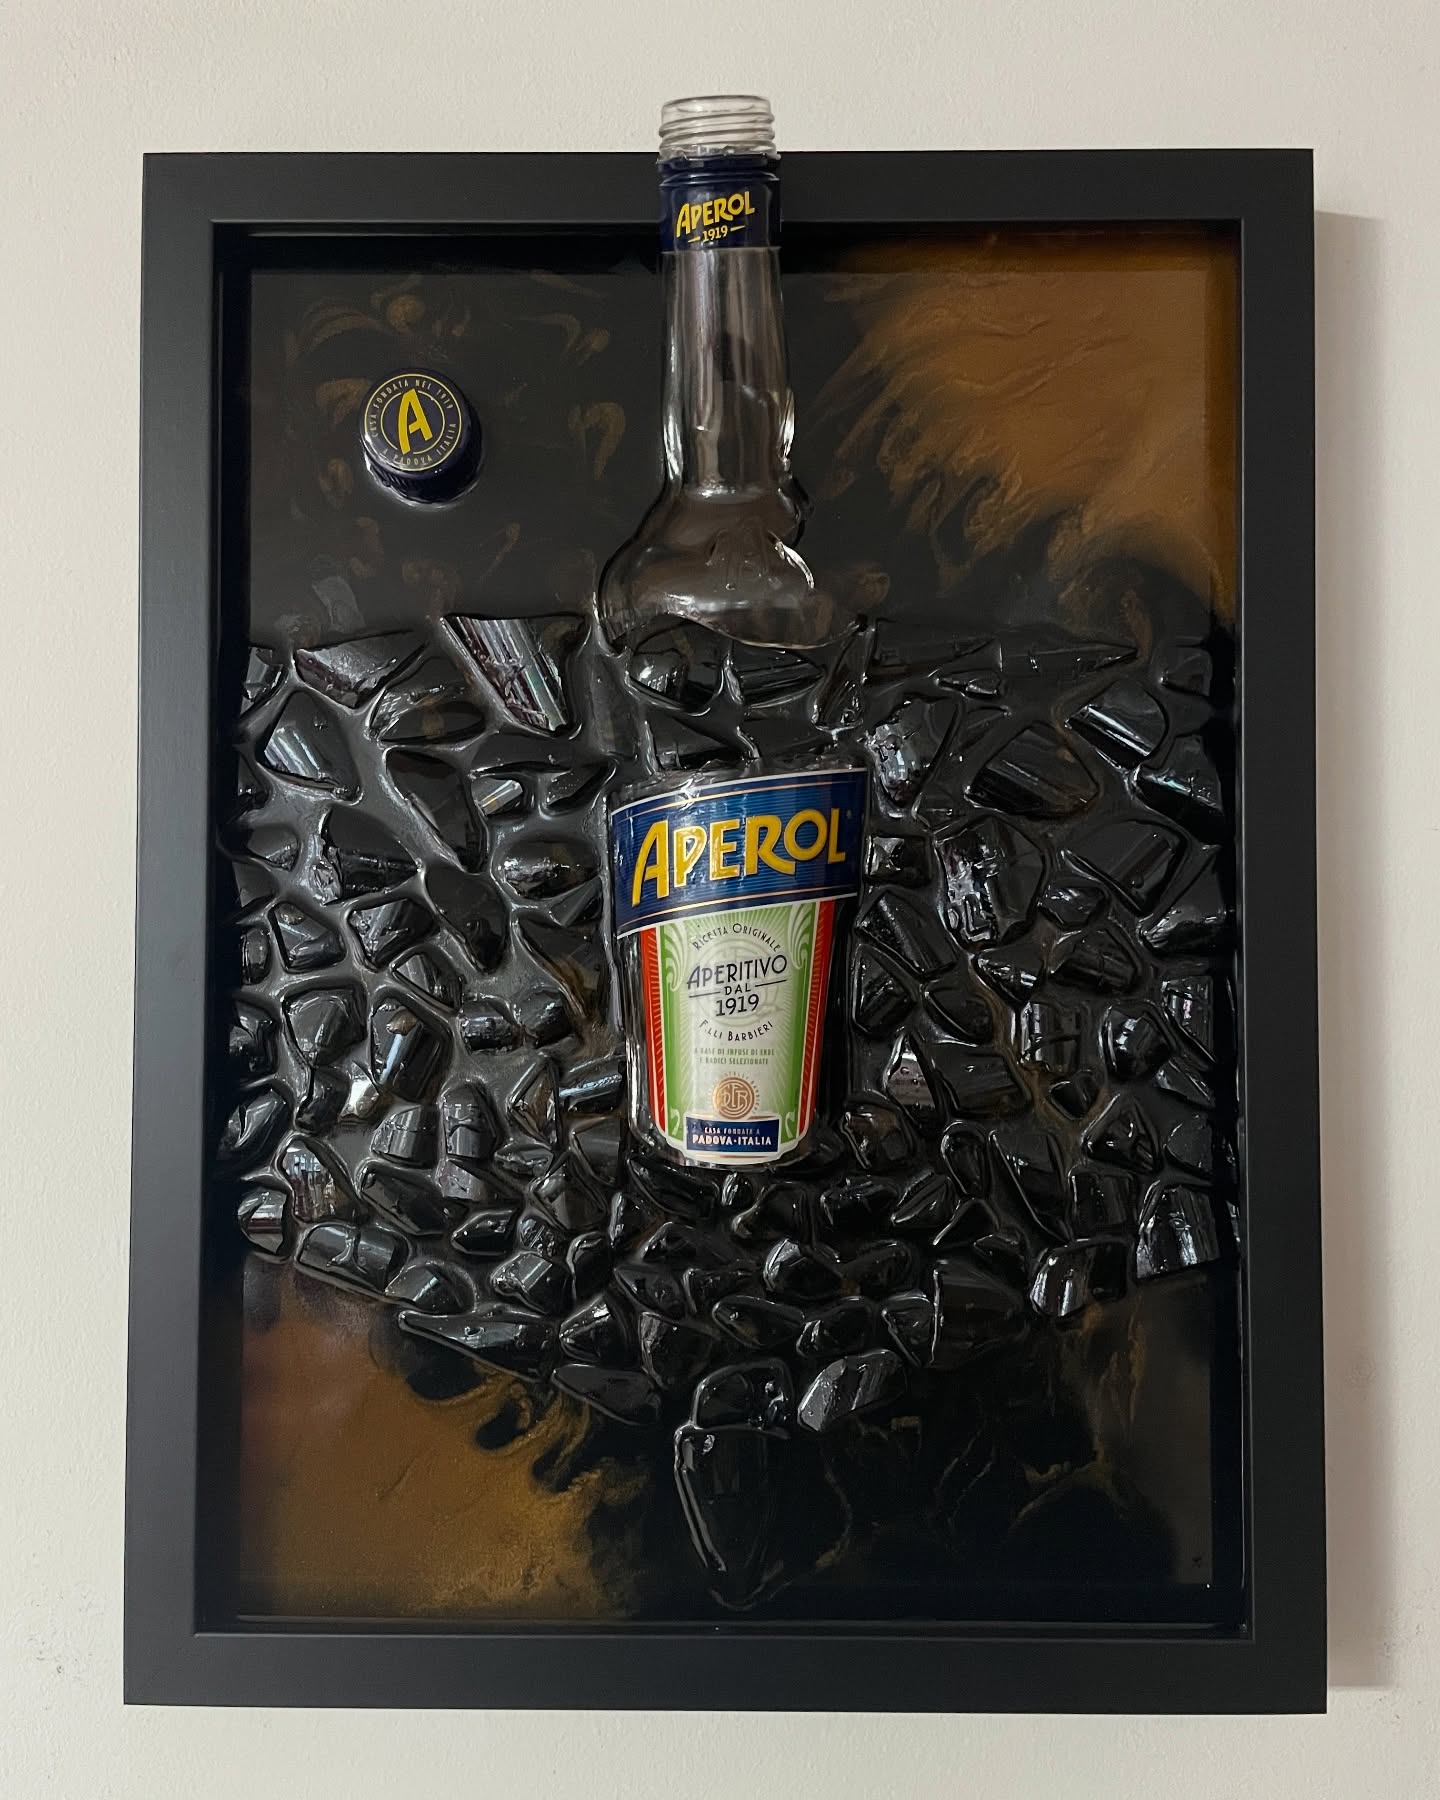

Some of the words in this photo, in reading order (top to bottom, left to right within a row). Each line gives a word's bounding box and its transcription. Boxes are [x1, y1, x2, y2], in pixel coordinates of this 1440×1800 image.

[676, 191, 756, 238] APEROL
[702, 225, 728, 242] 1919
[373, 379, 409, 409] FONDATA
[415, 379, 432, 390] NEL
[436, 389, 454, 409] 1919
[398, 388, 433, 455] A
[436, 423, 457, 455] ITALIA
[632, 808, 846, 907] APEROL
[692, 926, 728, 951] RICETTA
[732, 923, 780, 952] ORIGINALE
[686, 954, 787, 990] APERITIVO
[724, 983, 751, 996] DAL
[715, 994, 759, 1017] 1919
[728, 1020, 773, 1041] BARBIERI
